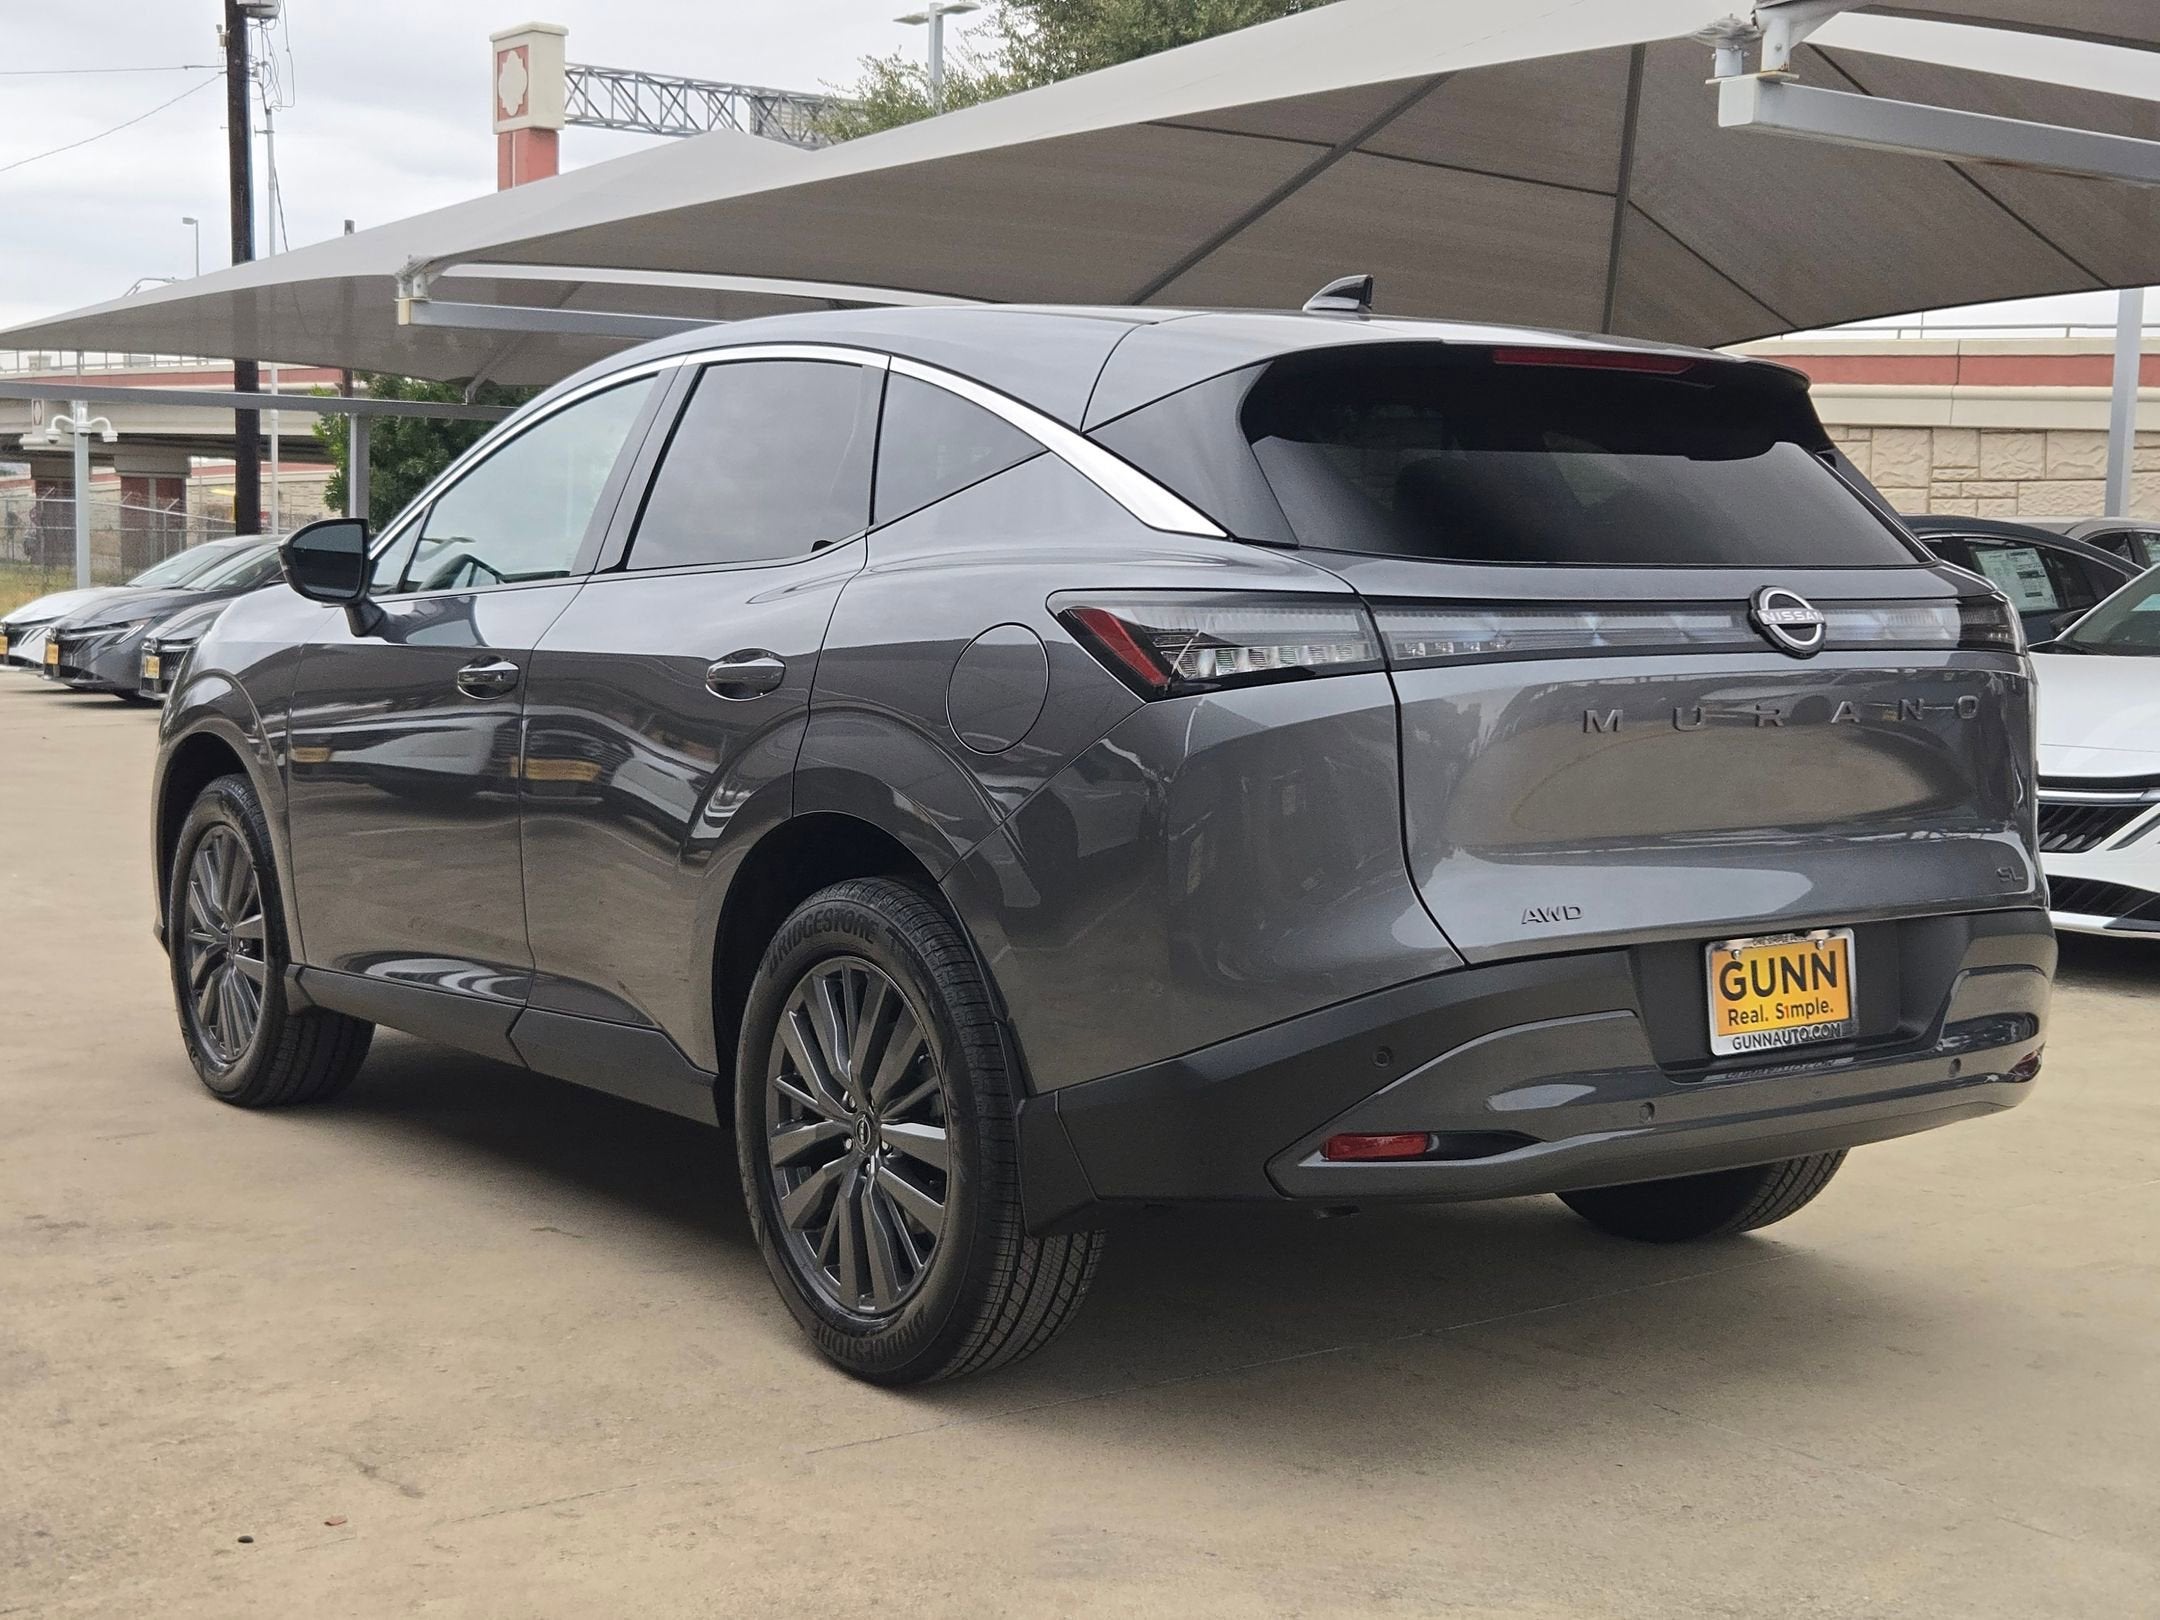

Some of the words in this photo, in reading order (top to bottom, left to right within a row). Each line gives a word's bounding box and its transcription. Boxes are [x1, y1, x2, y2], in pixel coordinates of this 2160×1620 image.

[1760, 609, 1824, 623] NISSAN
[1583, 695, 1979, 733] MURANO
[1521, 905, 1582, 925] AWD
[767, 907, 880, 978] BRIDGESTONE
[1719, 951, 1838, 1001] GUNN
[1728, 1004, 1769, 1026] Real.
[1732, 1022, 1841, 1051] GUNNAUTO.COM
